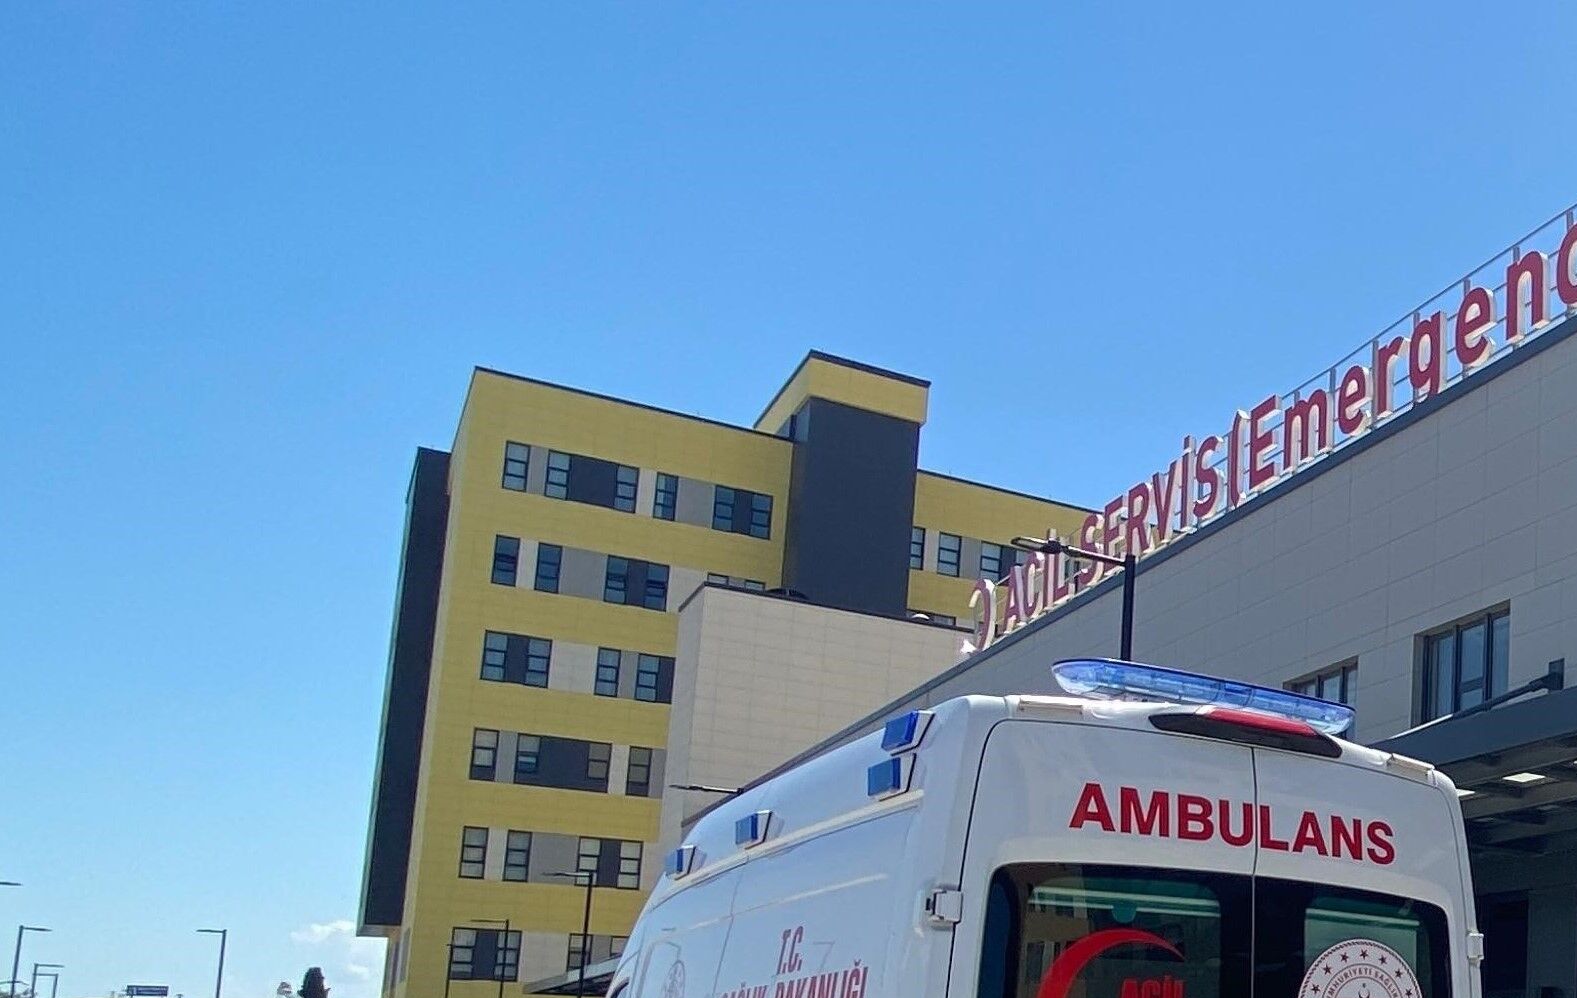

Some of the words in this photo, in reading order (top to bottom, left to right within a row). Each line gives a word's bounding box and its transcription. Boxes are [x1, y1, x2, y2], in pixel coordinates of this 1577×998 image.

[1075, 435, 1225, 585] SERVİS
[1068, 782, 1396, 866] AMBULANS
[776, 925, 804, 975] T.C.
